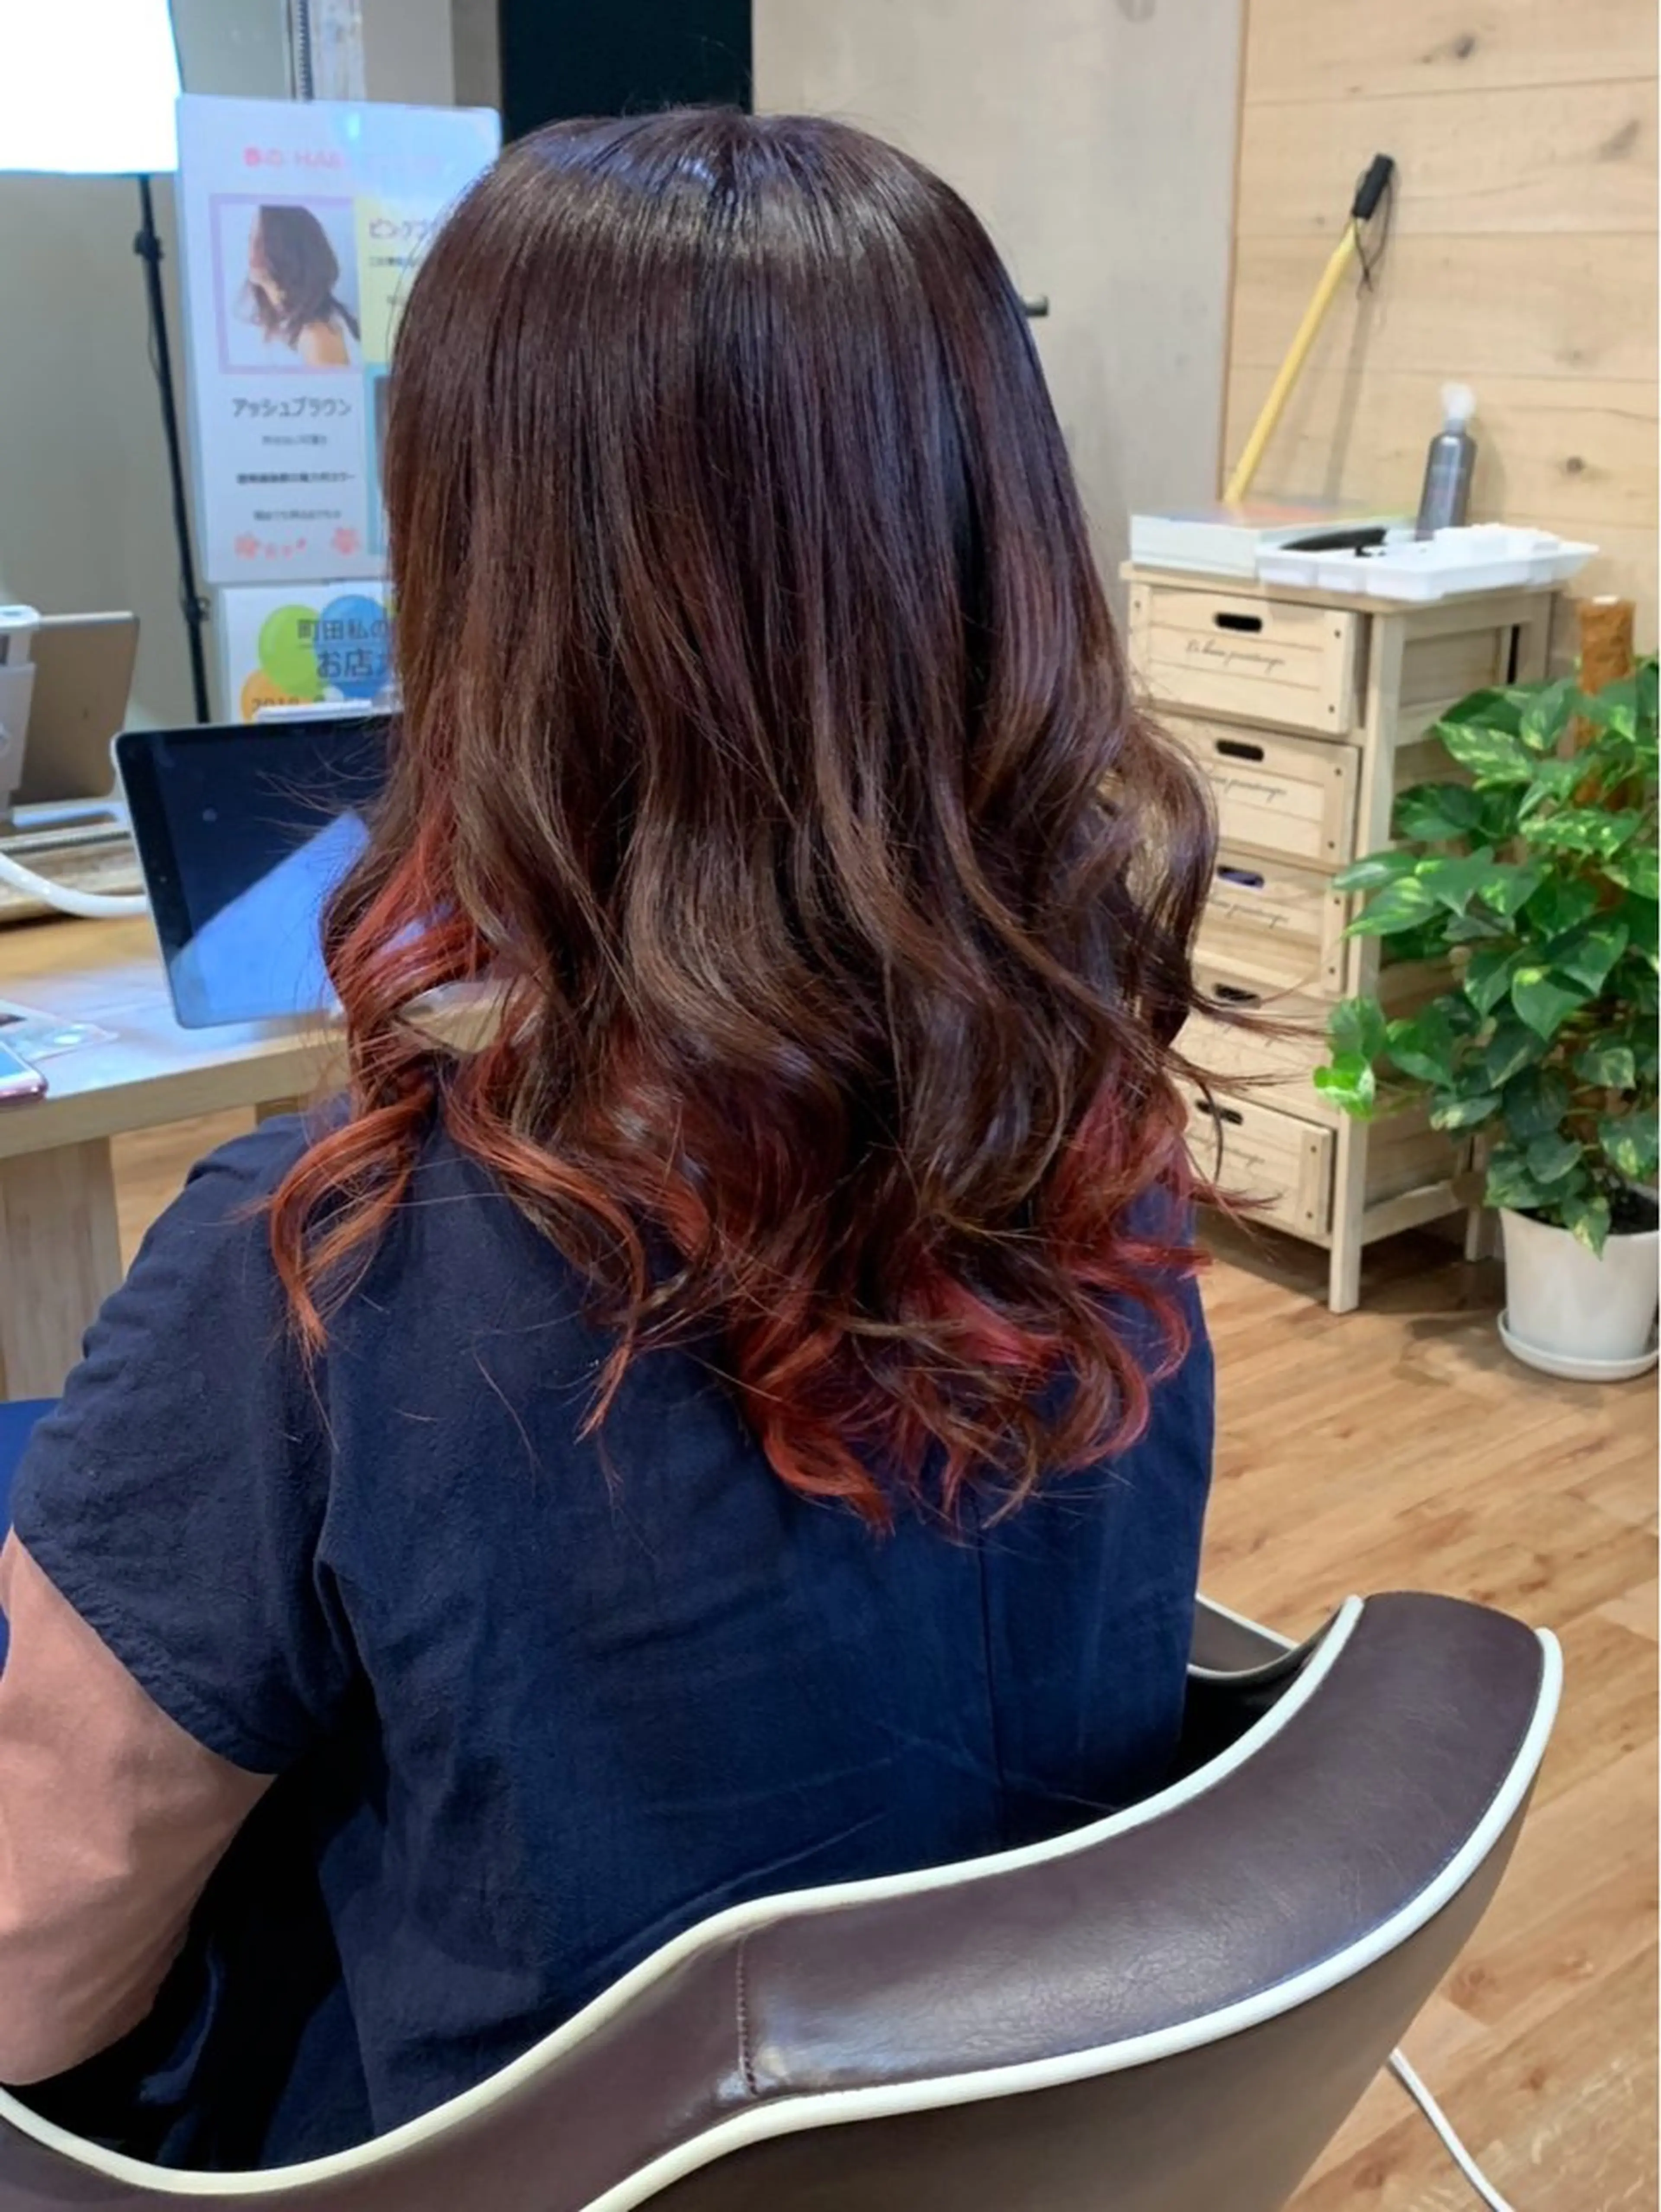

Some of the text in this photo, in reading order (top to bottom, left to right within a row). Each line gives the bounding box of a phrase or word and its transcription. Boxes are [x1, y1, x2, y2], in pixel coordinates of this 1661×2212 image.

[232, 397, 352, 417] アッシュブラウン
